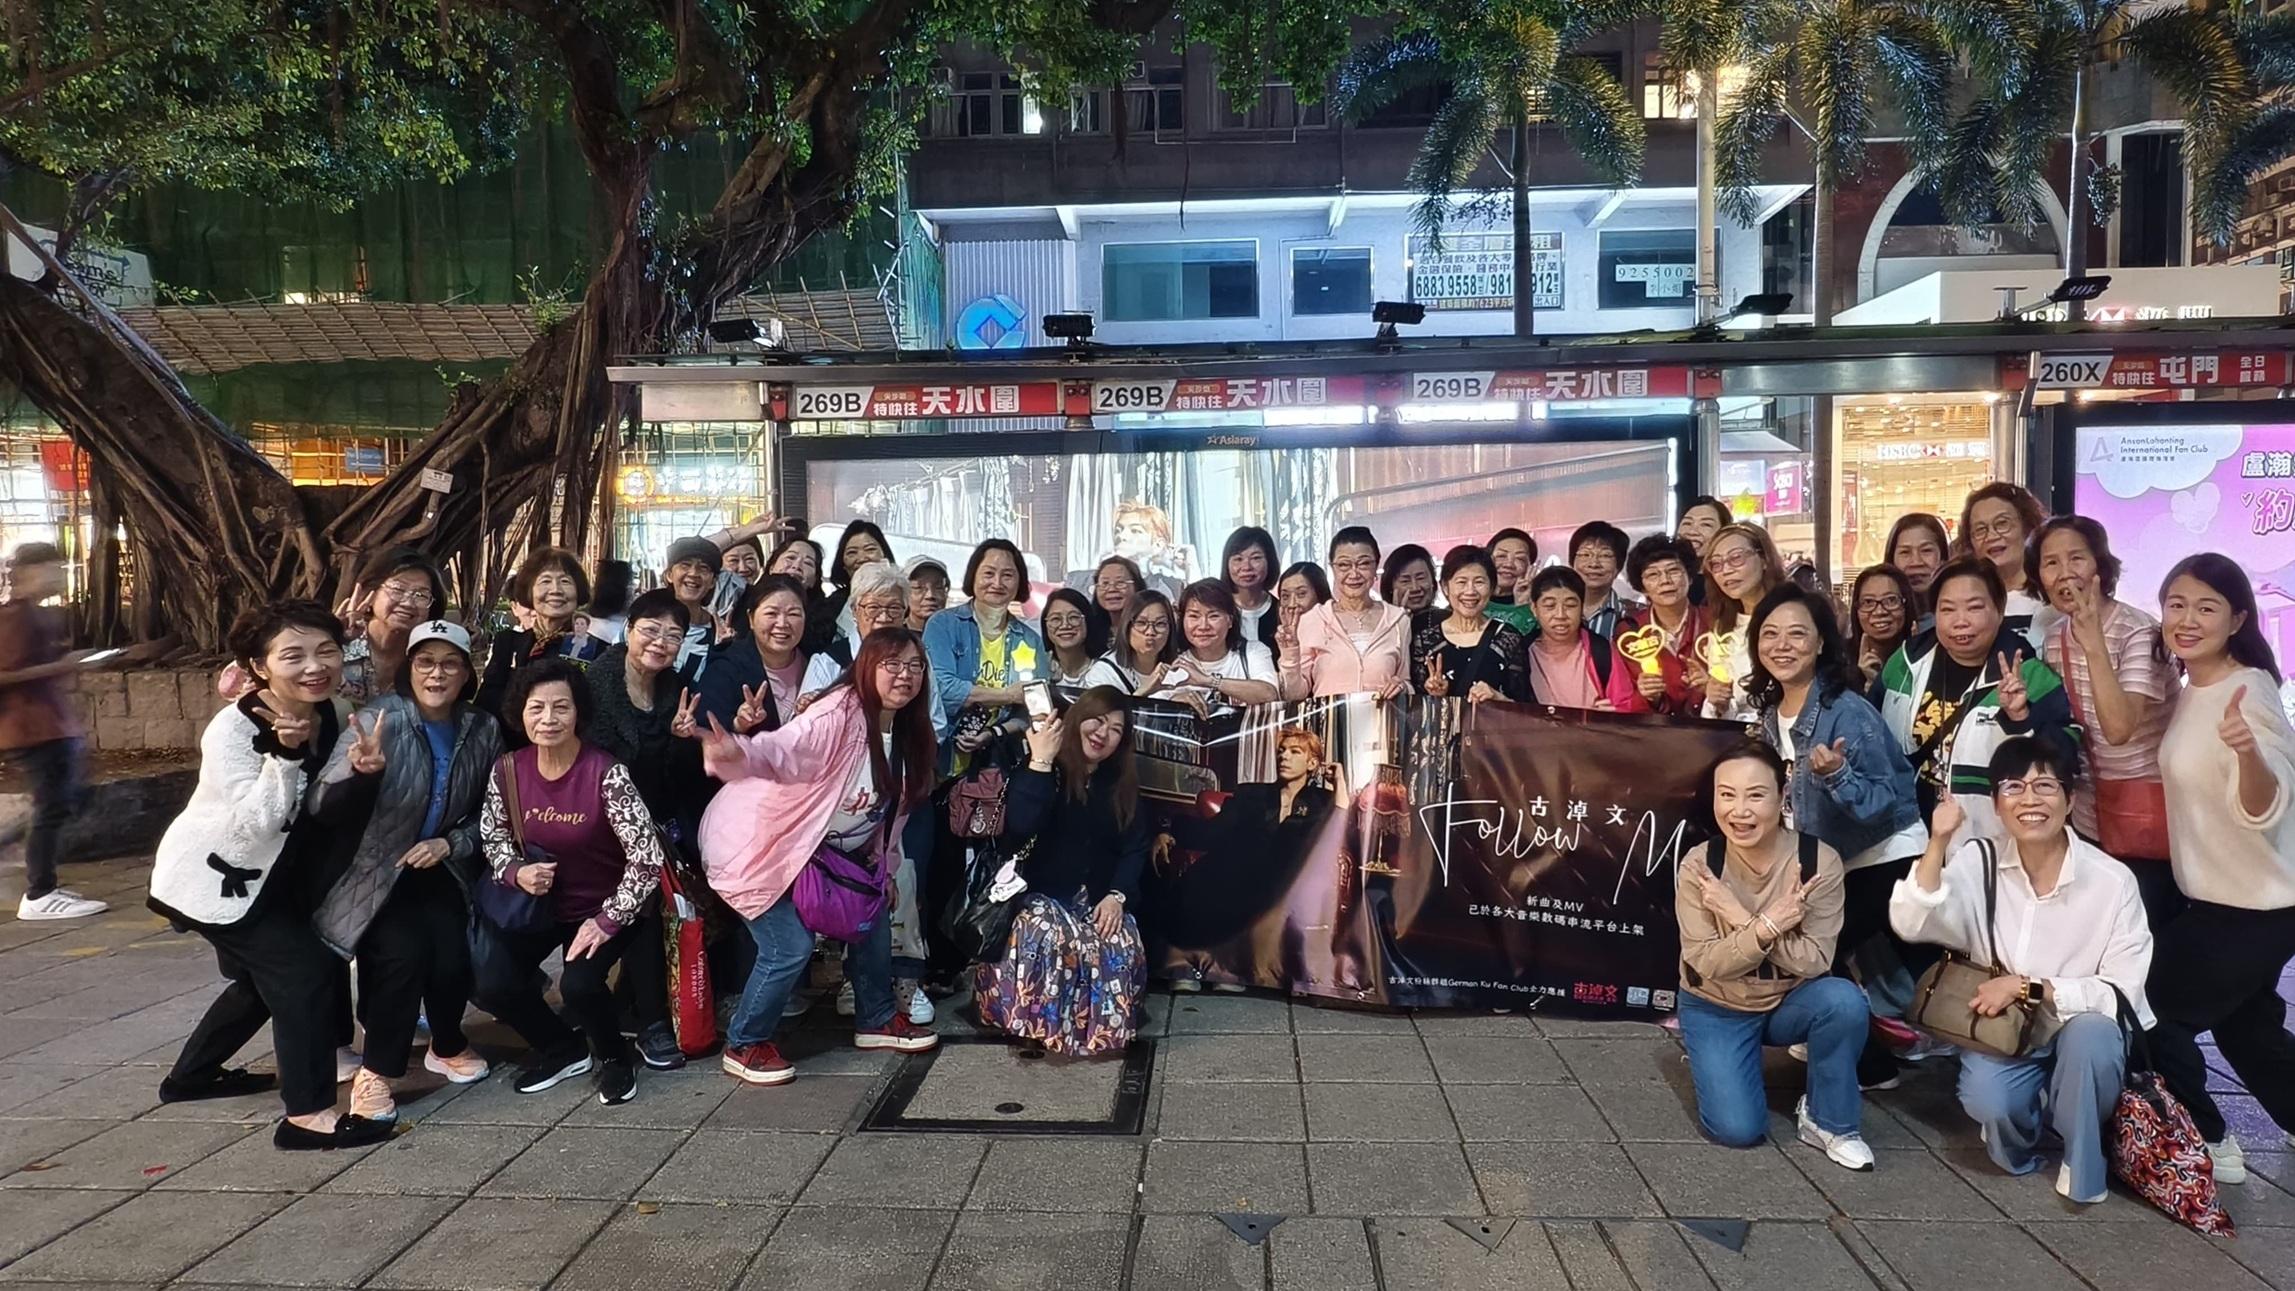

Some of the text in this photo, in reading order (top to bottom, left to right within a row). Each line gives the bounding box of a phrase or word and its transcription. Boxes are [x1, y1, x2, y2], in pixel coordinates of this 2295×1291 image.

[1415, 276, 1444, 297] 6883
[1449, 274, 1477, 296] 9558
[2040, 361, 2101, 383] 260X
[2159, 355, 2219, 384] 屯門
[1227, 377, 1327, 408] 天水圍
[1417, 377, 1482, 398] 269B
[1545, 369, 1648, 399] 天水圍
[800, 393, 862, 414] 269B
[922, 385, 1020, 415] 天水圍
[1099, 386, 1164, 408] 269B
[2190, 444, 2208, 453] Club
[2241, 450, 2295, 478] 盧瀚
[2252, 488, 2295, 535] 約
[430, 621, 448, 634] LA
[1529, 796, 1627, 826] 古淖文
[1419, 782, 1582, 887] Follow
[1526, 894, 1585, 912] 新曲及MV
